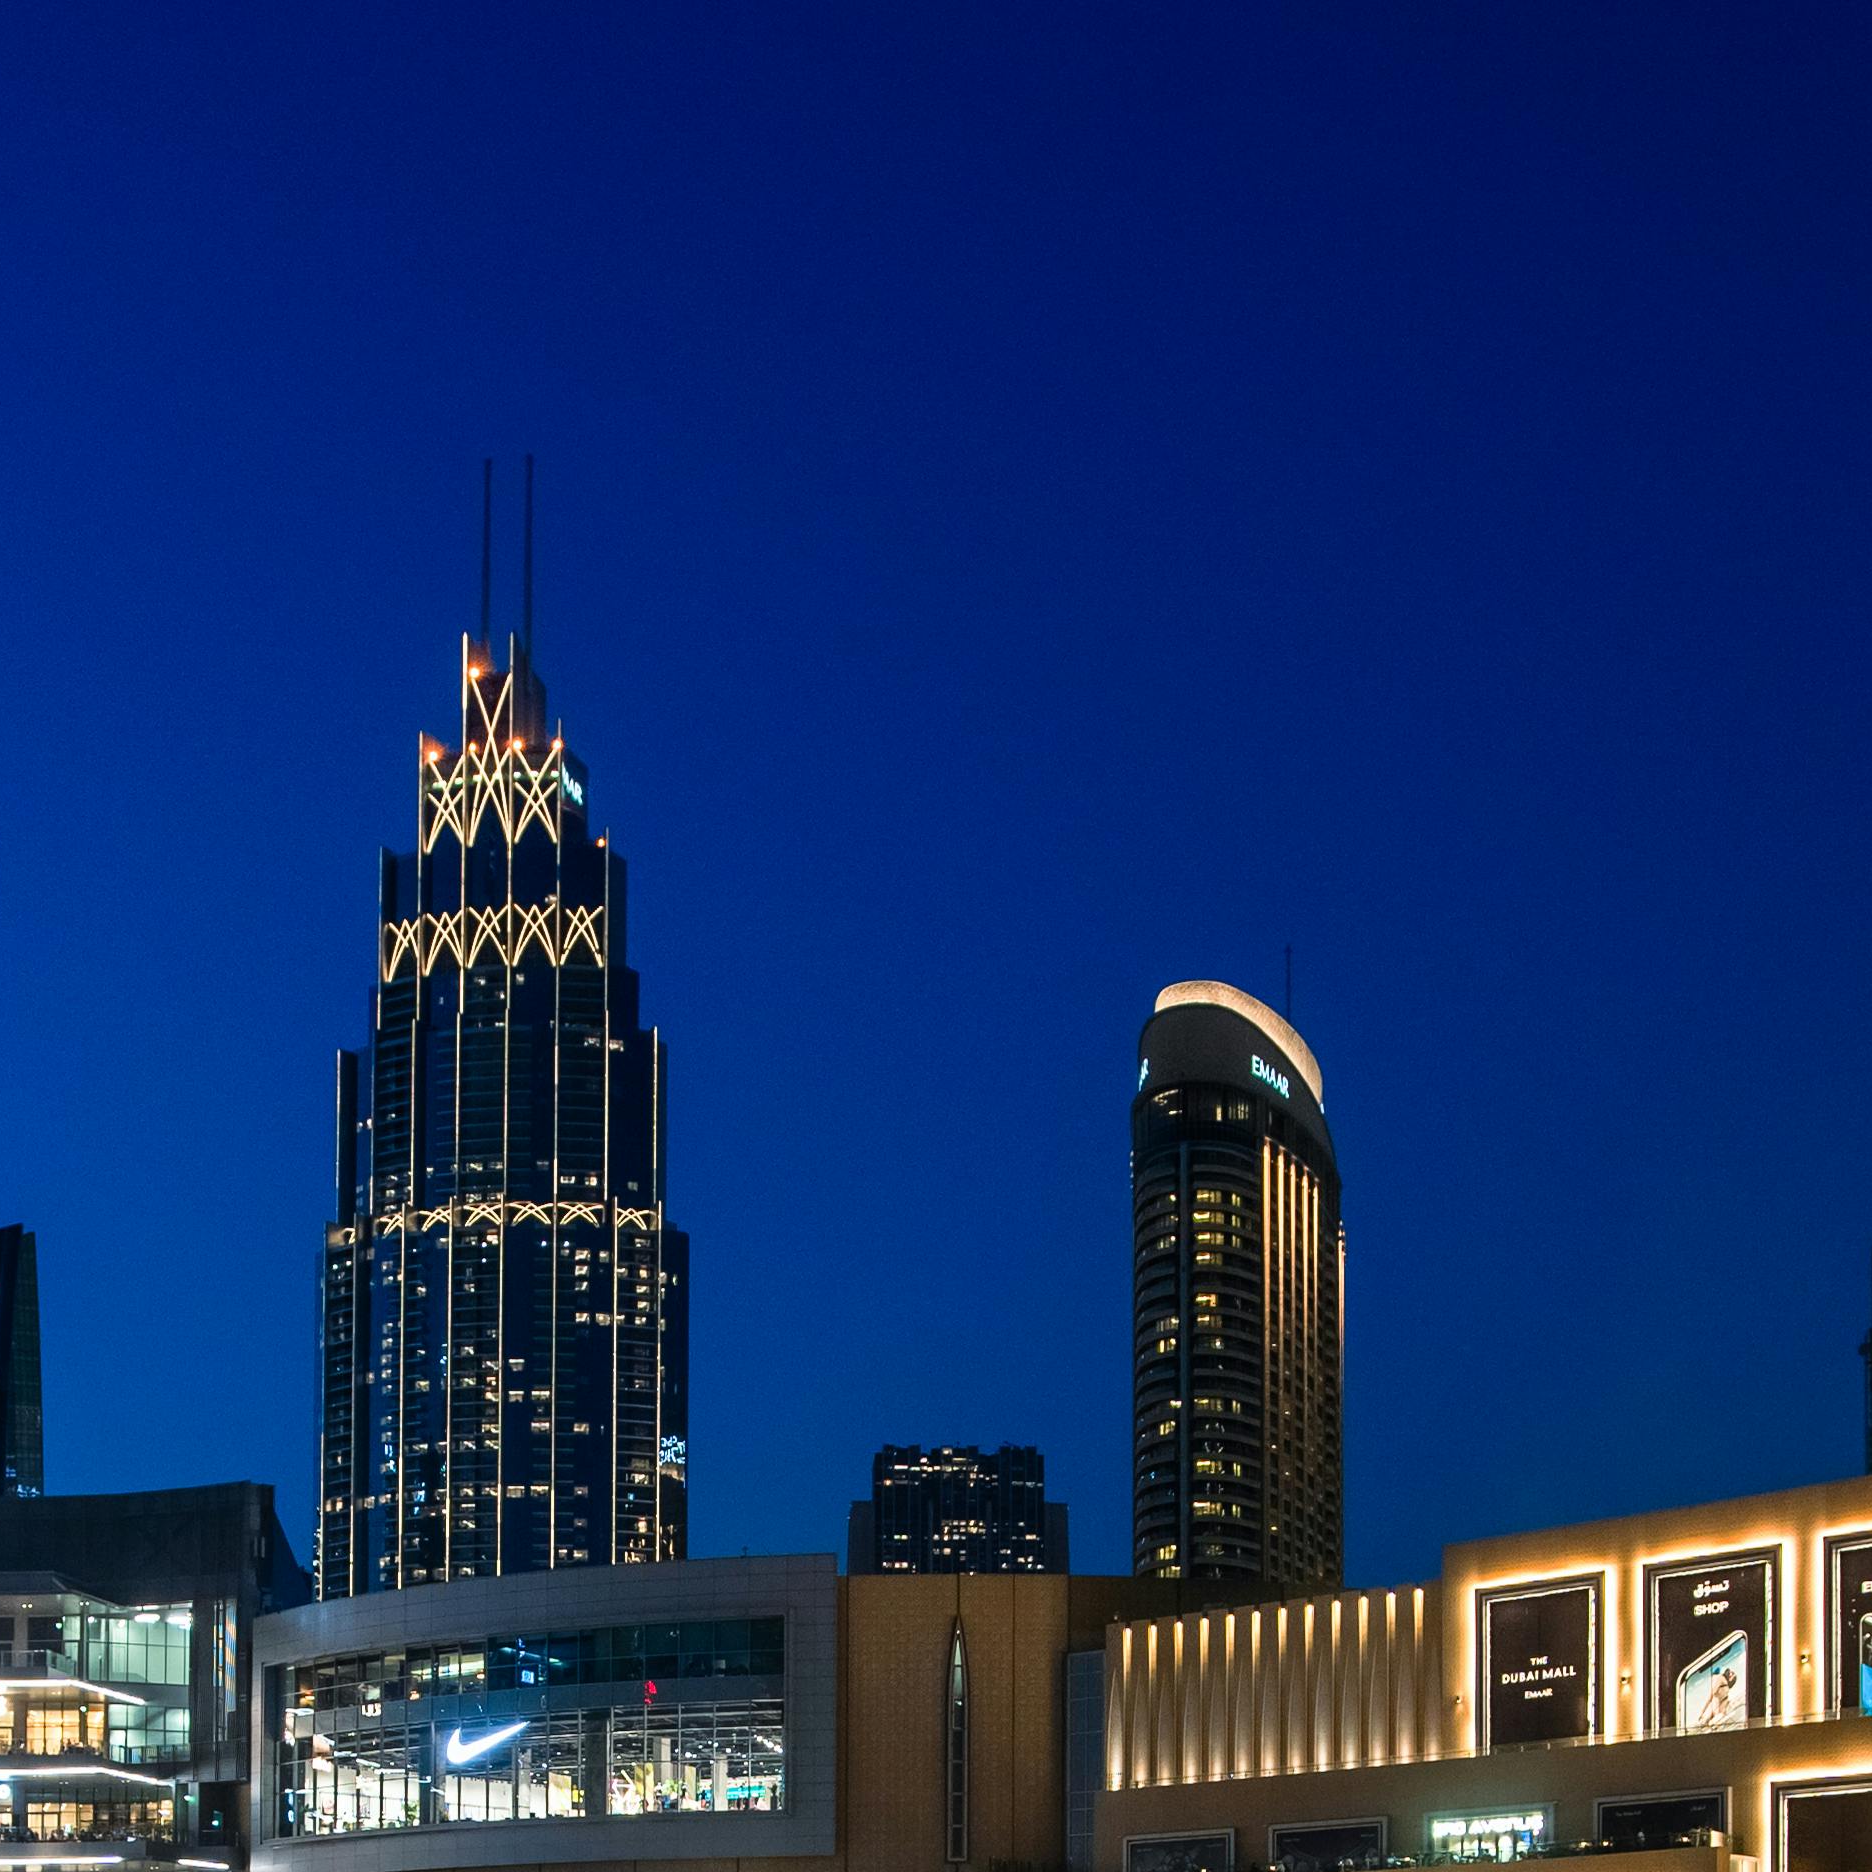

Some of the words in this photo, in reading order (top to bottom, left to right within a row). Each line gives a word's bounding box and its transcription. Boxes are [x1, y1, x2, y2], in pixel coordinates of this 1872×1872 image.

[1251, 1054, 1290, 1099] EMAAR
[1693, 1600, 1730, 1616] SHOP
[1530, 1656, 1548, 1666] THE
[1501, 1670, 1540, 1685] DUBAI
[1542, 1666, 1577, 1680] MALL
[1524, 1688, 1553, 1700] EMAAR
